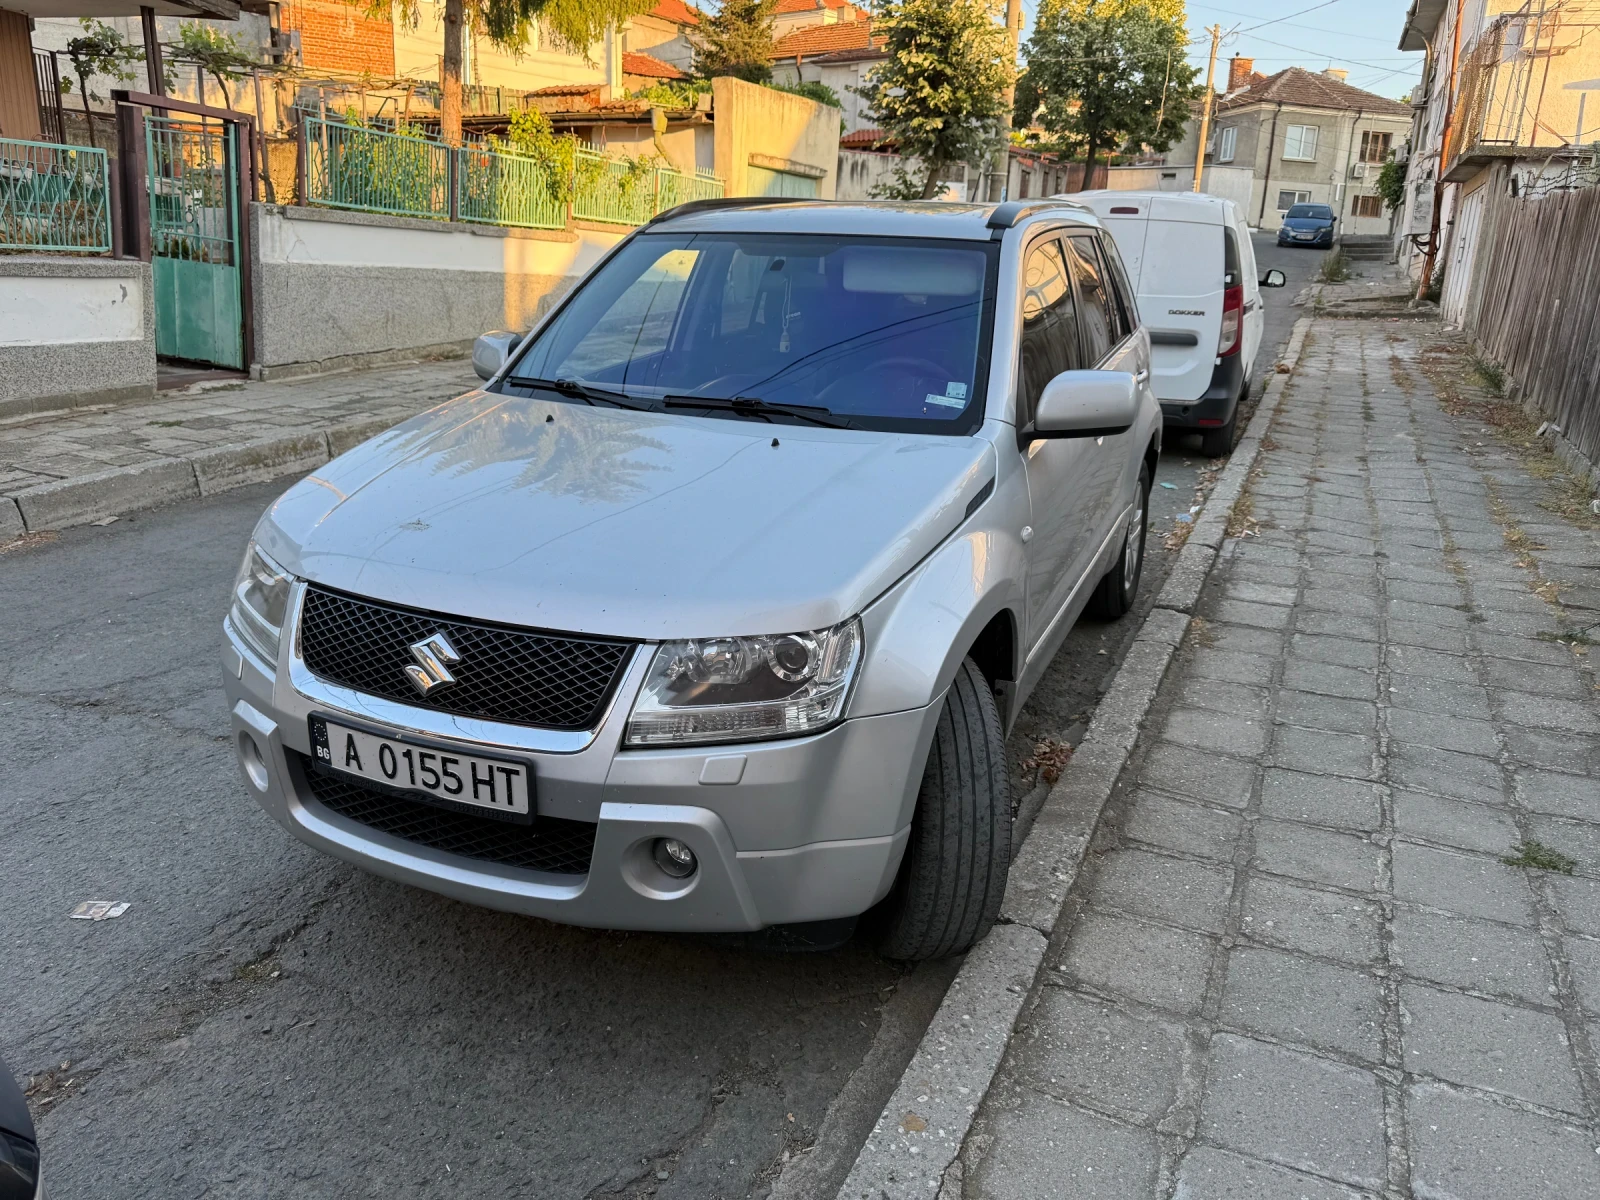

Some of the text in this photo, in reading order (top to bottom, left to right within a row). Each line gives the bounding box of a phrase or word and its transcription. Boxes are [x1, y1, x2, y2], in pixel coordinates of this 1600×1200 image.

[1168, 309, 1205, 317] DOKKER
[317, 746, 330, 760] BG
[345, 733, 363, 771] A
[379, 743, 463, 795] 0155
